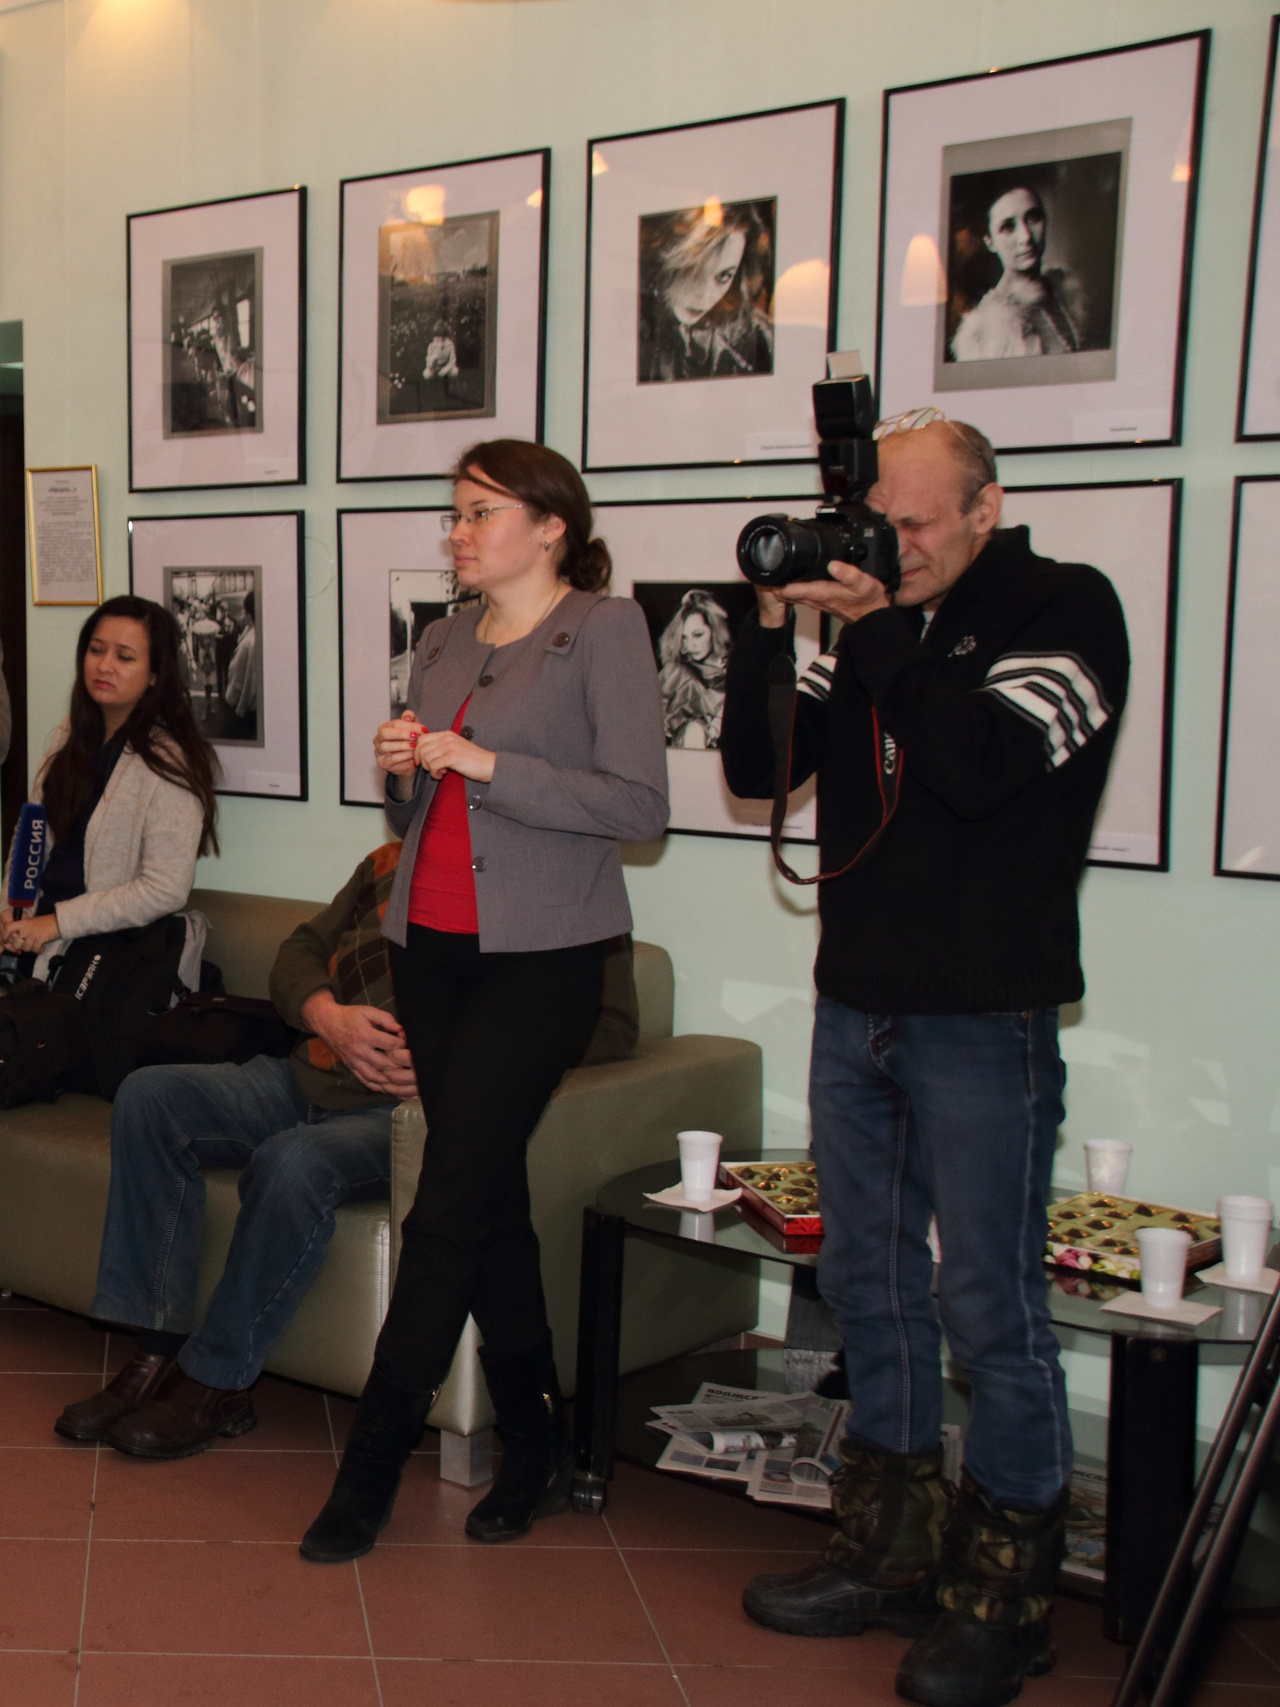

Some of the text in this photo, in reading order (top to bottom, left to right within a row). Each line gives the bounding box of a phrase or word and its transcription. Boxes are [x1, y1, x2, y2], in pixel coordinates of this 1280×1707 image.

[23, 819, 45, 890] РОССИЯ
[74, 954, 102, 1001] ICEPEAK
[706, 1388, 767, 1400] ВОЛЖСК
